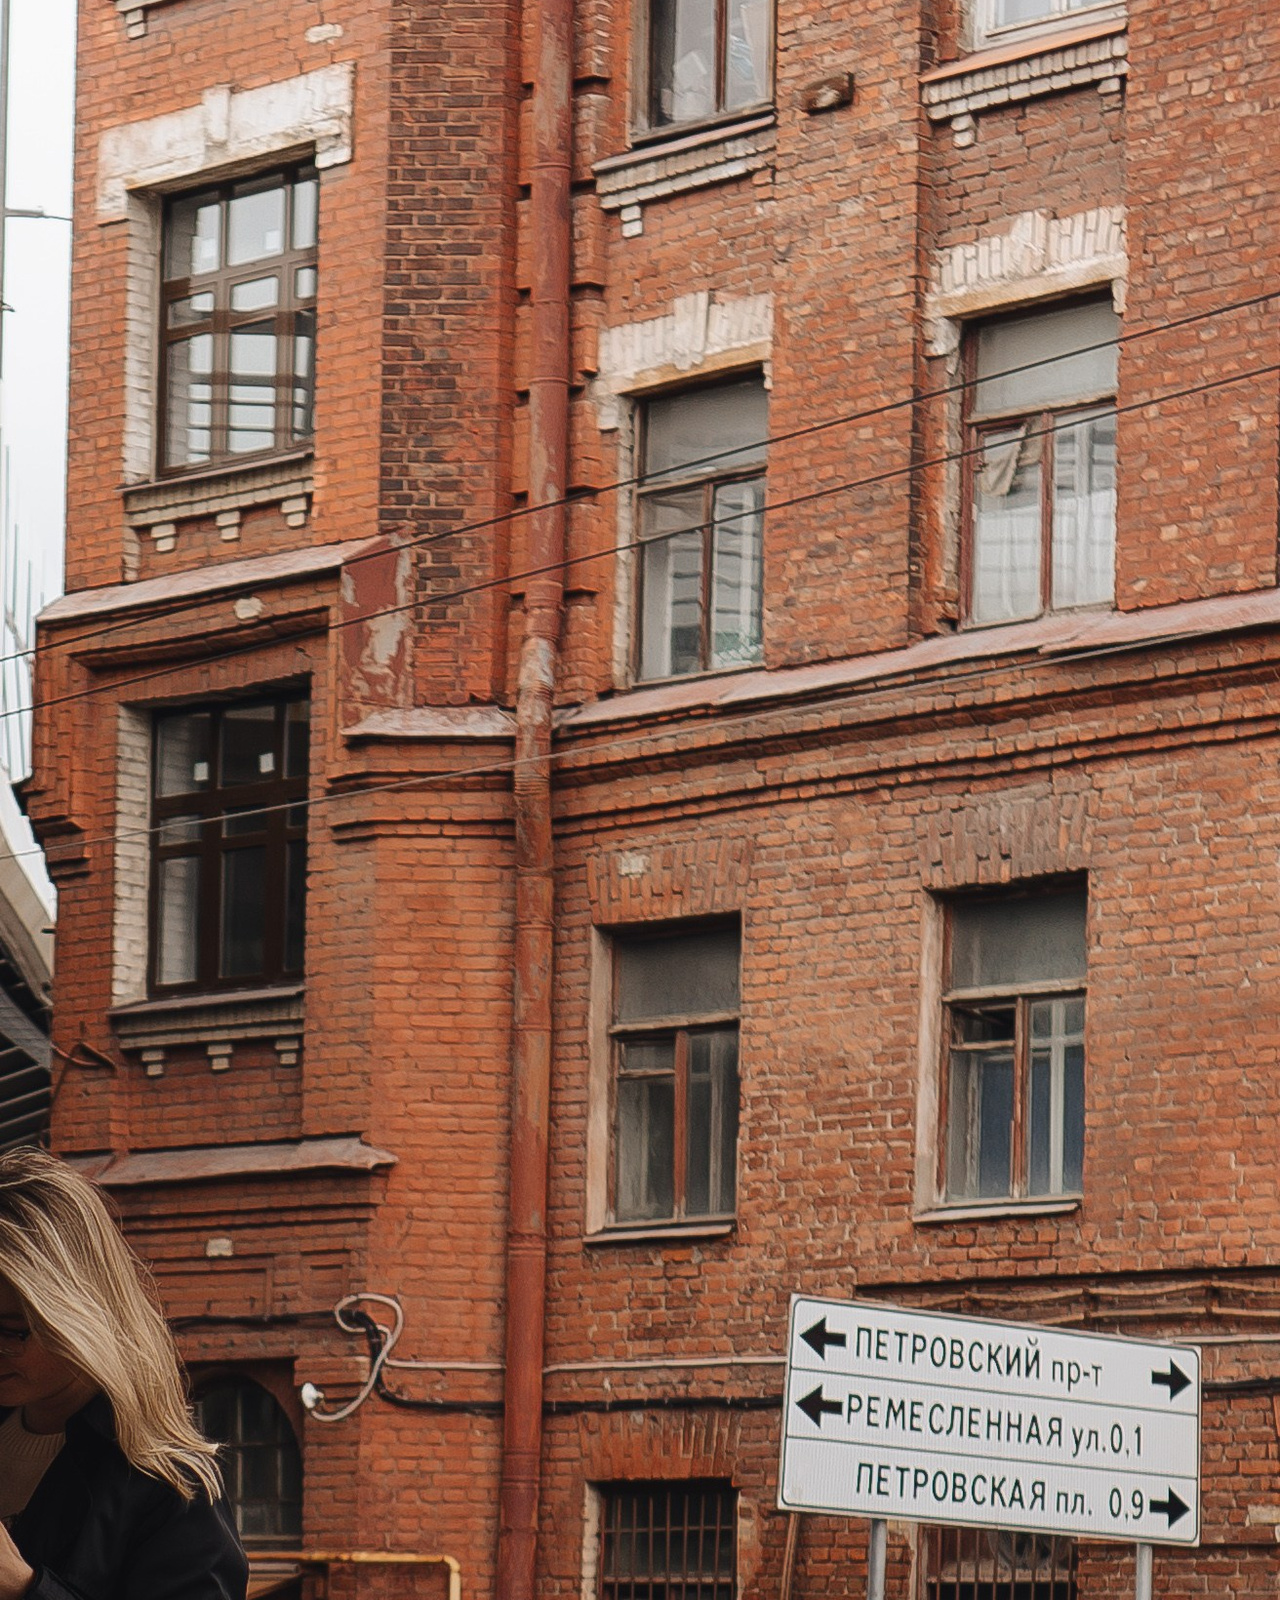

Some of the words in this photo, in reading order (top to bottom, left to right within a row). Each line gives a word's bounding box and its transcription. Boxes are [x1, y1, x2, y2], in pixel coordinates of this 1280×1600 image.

[856, 1326, 1040, 1380] ПЕТРОВСКИЙ
[1052, 1360, 1102, 1393] пр-т
[847, 1393, 1062, 1448] РЕМЕСЛЕННАЯ
[856, 1462, 1046, 1511] ПЕТРОВСКАЯ
[1056, 1491, 1093, 1516] пл.
[1108, 1487, 1144, 1521] 0,9
